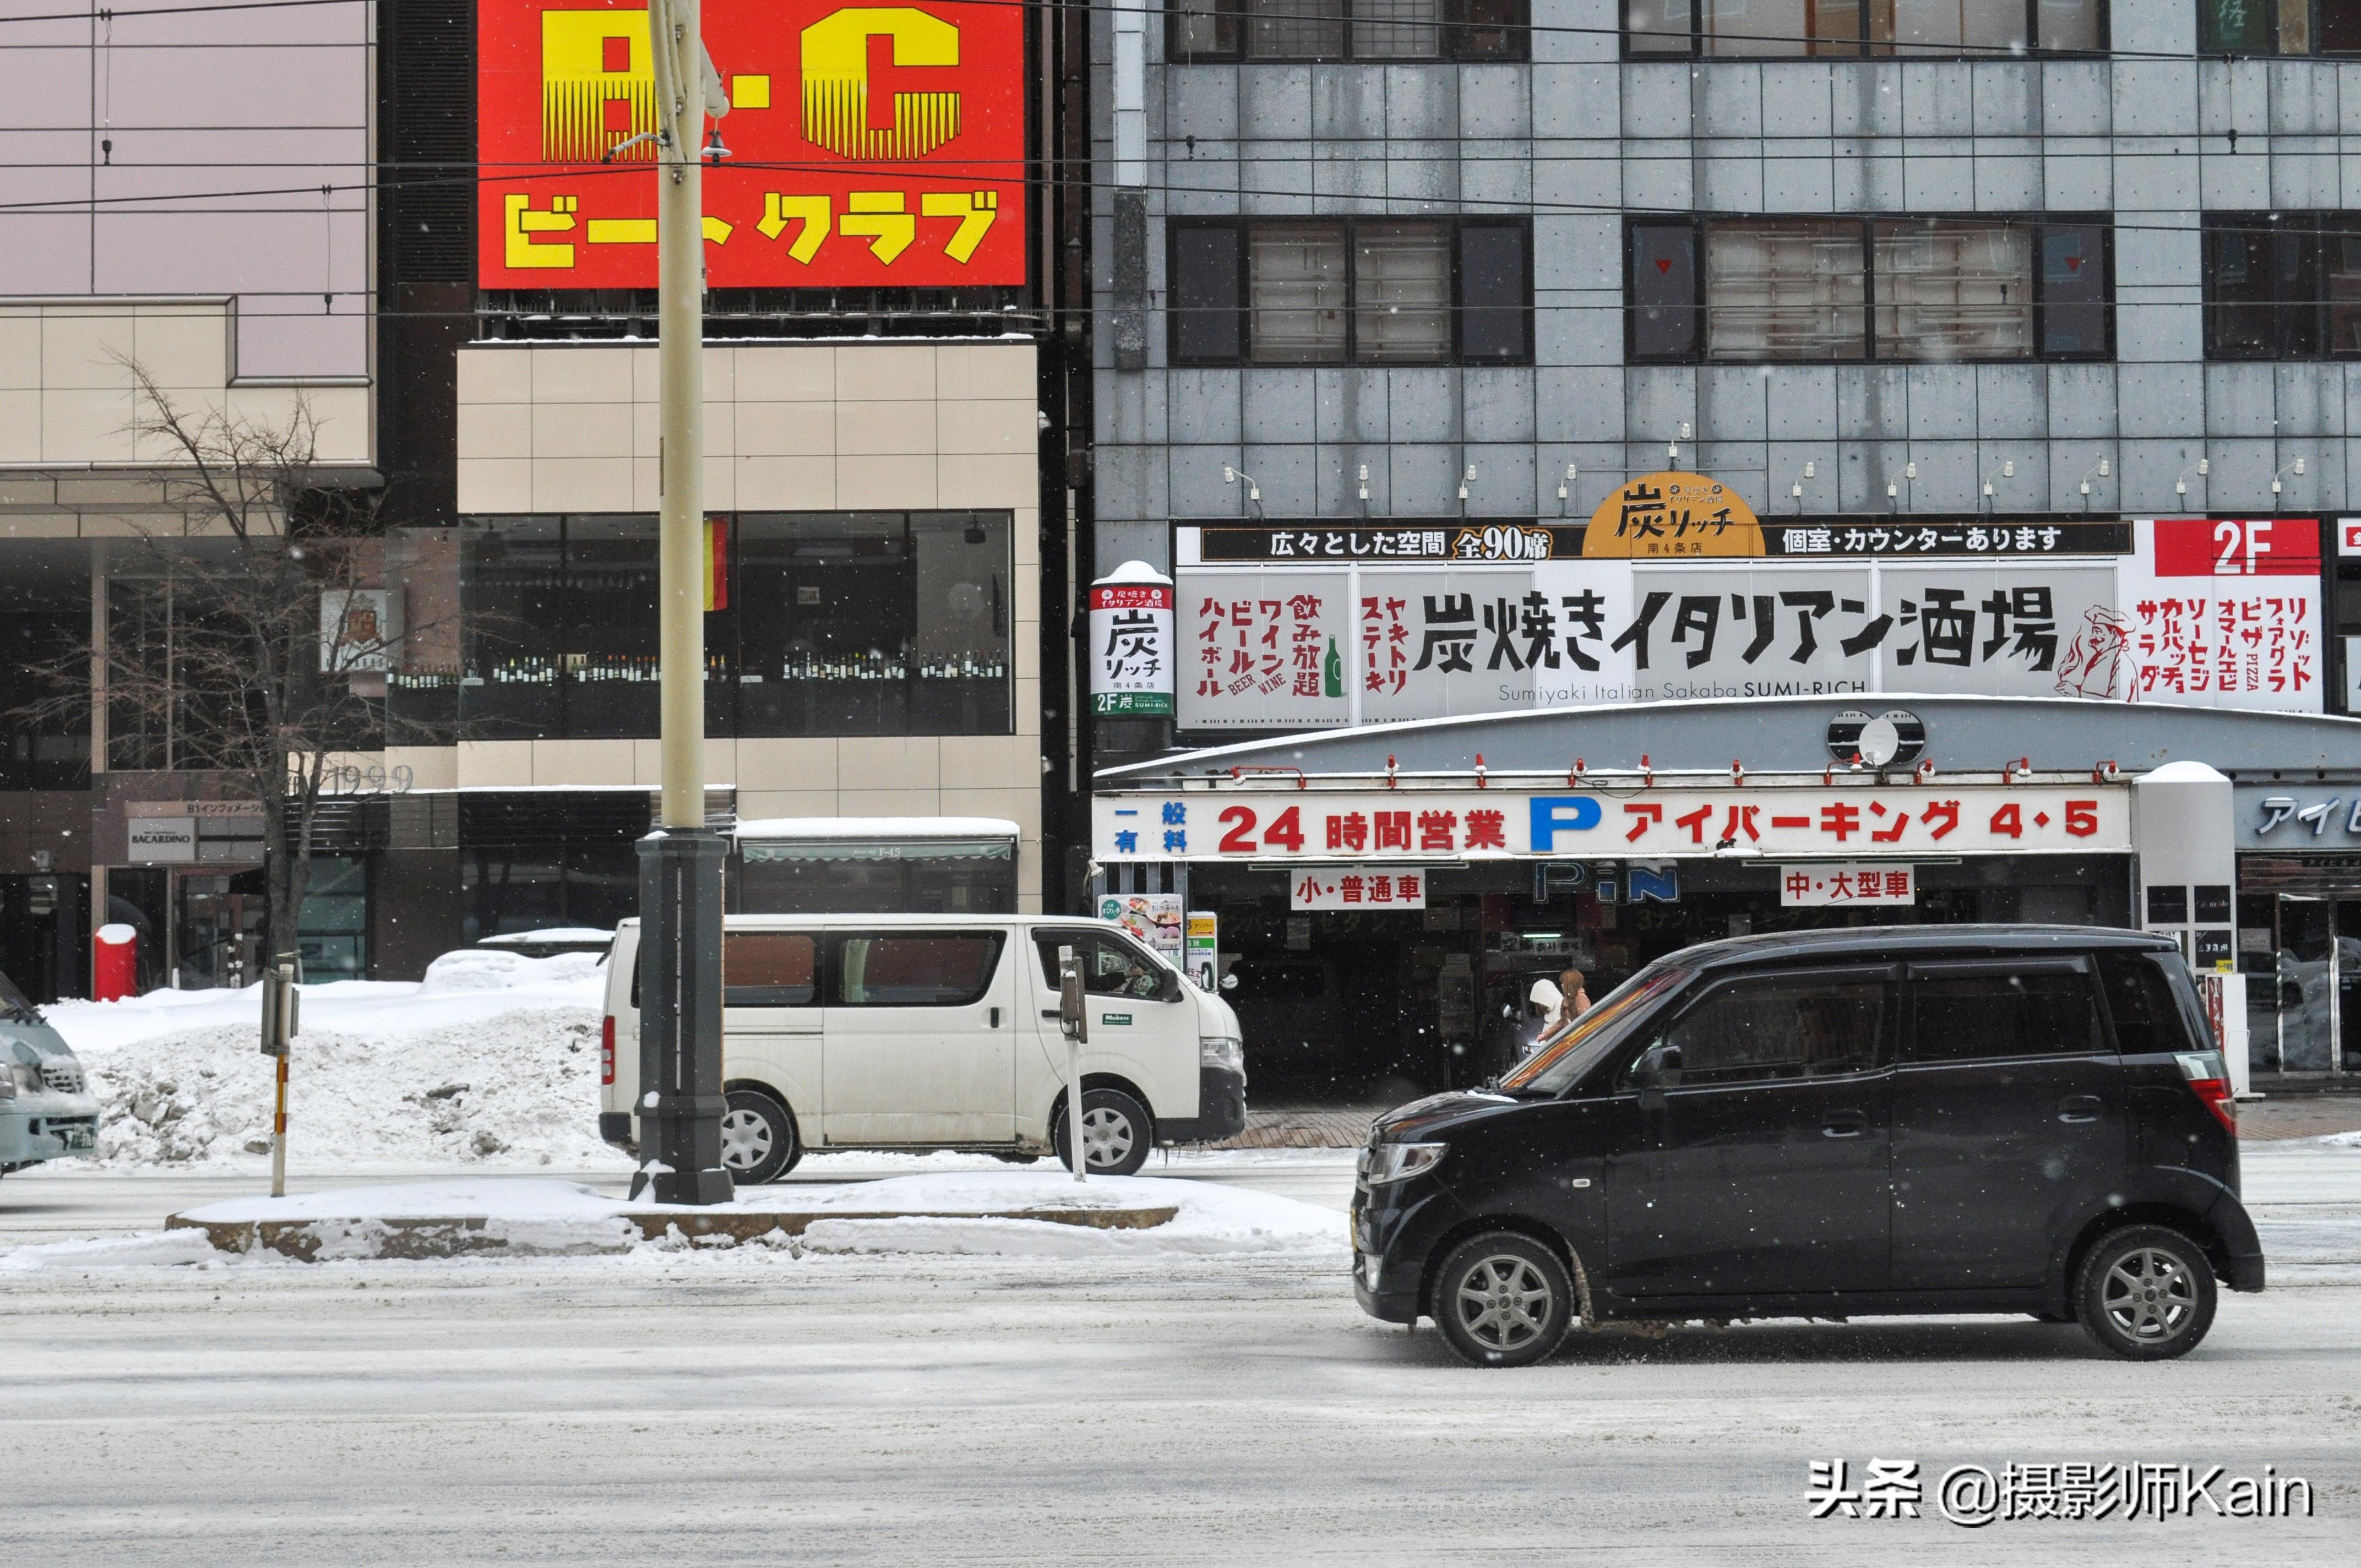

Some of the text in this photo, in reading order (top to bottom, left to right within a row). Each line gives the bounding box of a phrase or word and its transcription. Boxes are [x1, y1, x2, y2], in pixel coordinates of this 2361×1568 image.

[1613, 482, 1734, 539] 炭リッチ
[1270, 526, 1550, 560] 広々とした空間 全90席
[1647, 542, 1702, 554] 南4条店
[1782, 526, 2061, 553] 個室・カウンターあります
[2214, 521, 2272, 574] 2F
[1101, 599, 1163, 608] イタリアン酒場
[2240, 596, 2263, 649] ピザ
[1196, 597, 1226, 697] ハイボール
[1228, 600, 1256, 675] ビール
[1258, 600, 1284, 676] ワイン
[1286, 595, 1321, 697] 飲み放題
[1361, 596, 1386, 694] ステーキ
[1385, 597, 1409, 696] ヤキトリ
[1413, 587, 2059, 674] 炭焼きイタリアン酒場
[2136, 600, 2160, 692] サラダ
[2159, 598, 2185, 694] カルパッチョ
[2217, 599, 2238, 692] オマールエビ
[2265, 598, 2286, 693] フォアグラ
[2288, 597, 2312, 692] リゾット
[1106, 658, 1161, 679] リッチ
[1227, 673, 1256, 696] BEER
[1258, 673, 1287, 696] WINE
[1499, 680, 1865, 705] Sumiyaki Italian Sakaba SUMI-RICH
[2245, 653, 2259, 692] PIZZA
[1097, 693, 1117, 712] 2F
[132, 835, 191, 843] BACARDINO
[1218, 805, 1506, 852] 24時間営業
[1529, 796, 1603, 852] P
[1623, 799, 1961, 843] アイパーキング
[1297, 875, 1421, 904] 小・普通車
[1787, 872, 1910, 900] 中・大型車
